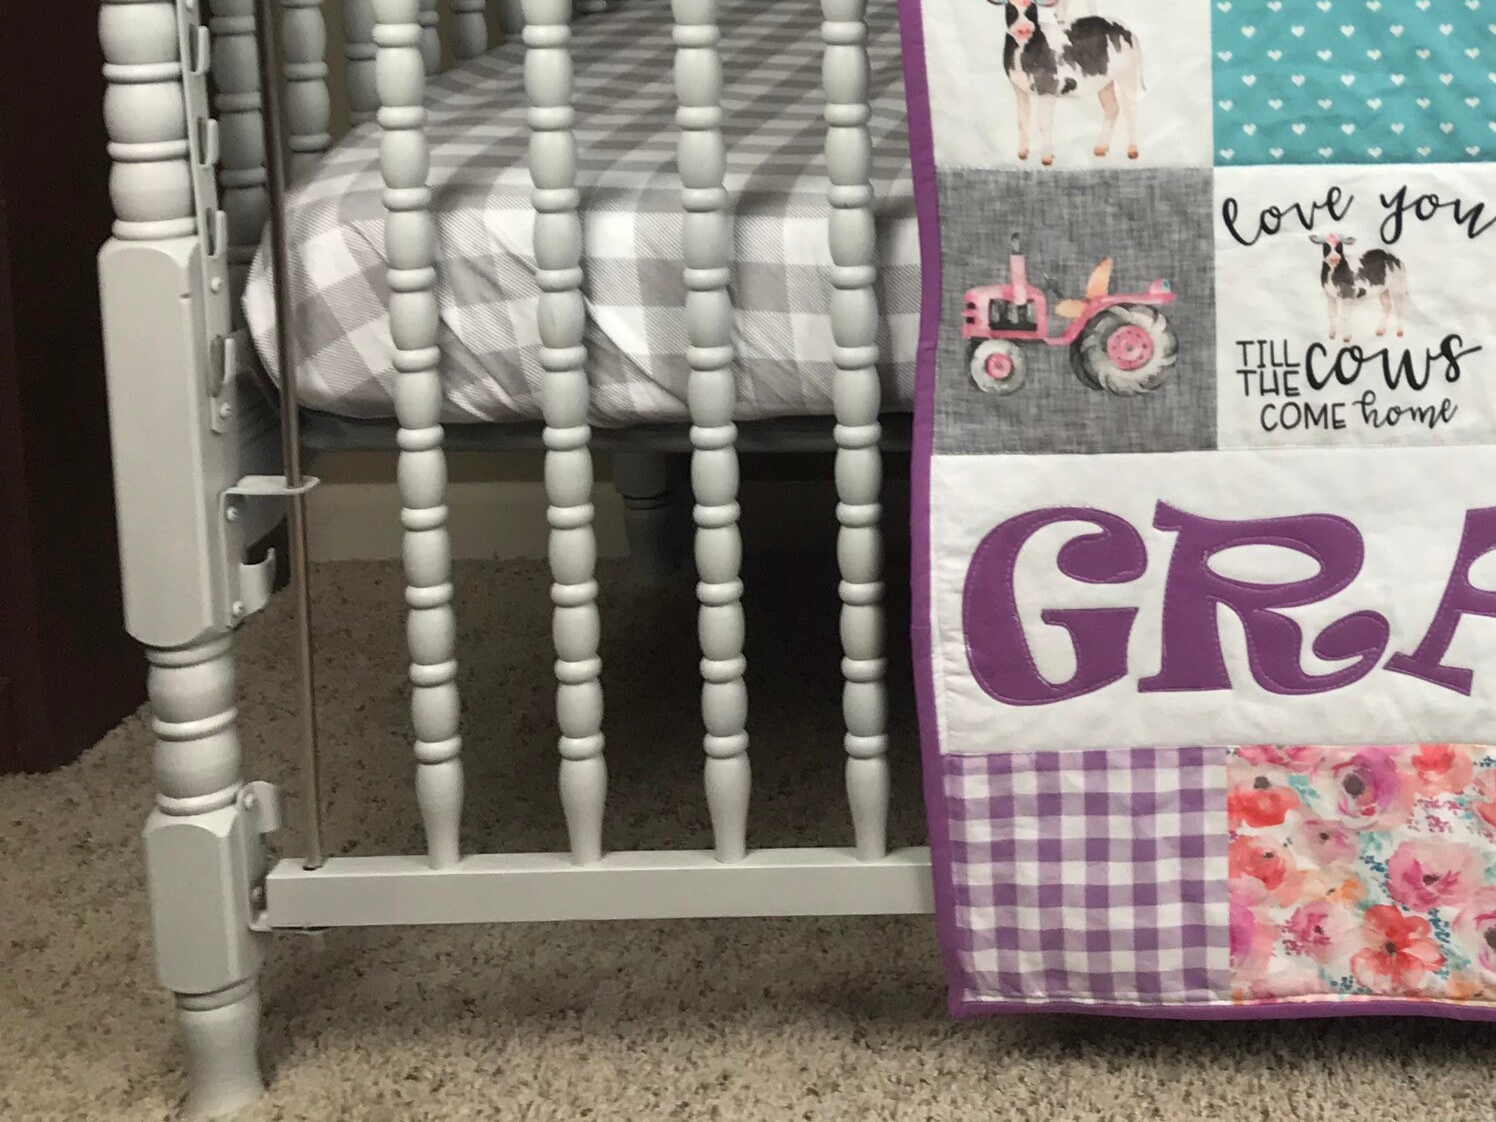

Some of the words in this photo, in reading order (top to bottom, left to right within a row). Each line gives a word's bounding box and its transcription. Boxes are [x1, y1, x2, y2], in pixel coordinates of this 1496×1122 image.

[1222, 186, 1354, 246] love
[1236, 339, 1300, 368] TILL
[1236, 370, 1300, 396] THE
[1260, 402, 1347, 431] COME
[1352, 390, 1458, 429] home
